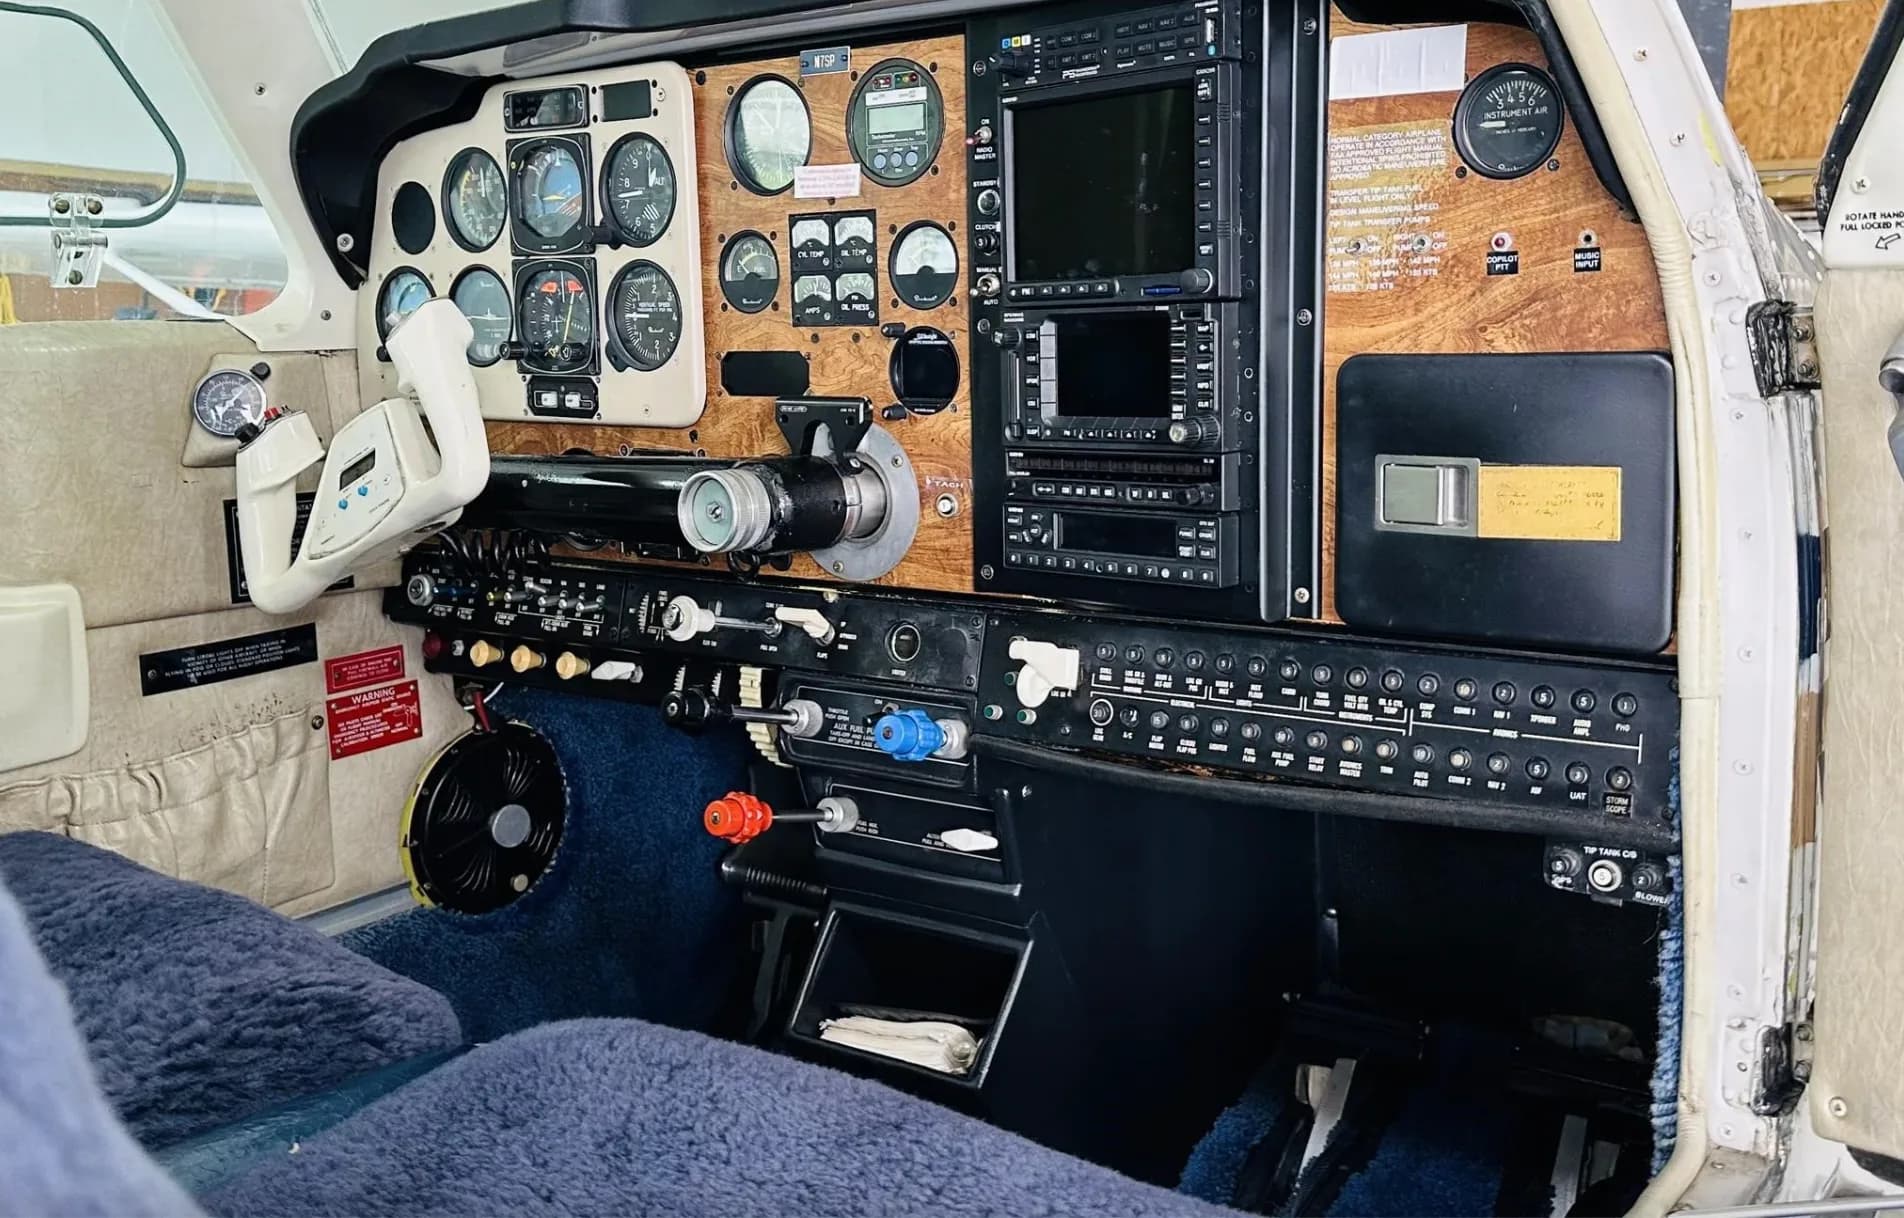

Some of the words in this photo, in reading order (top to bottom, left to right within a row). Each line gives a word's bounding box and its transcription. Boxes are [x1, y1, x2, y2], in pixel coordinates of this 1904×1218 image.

[1497, 99, 1504, 110] 3
[1507, 94, 1515, 103] 4
[1519, 92, 1525, 102] 5
[1528, 96, 1535, 106] 6
[1484, 109, 1531, 119] INSTRUMENT
[1534, 107, 1548, 115] AIR
[1363, 132, 1403, 141] CATEGORY
[1405, 129, 1441, 137] AIRPLANE
[1330, 142, 1364, 150] OPERATE
[1374, 137, 1425, 147] ACCORDANCE
[1346, 148, 1384, 157] APPROVED
[1385, 146, 1412, 154] FLIGHT
[632, 159, 638, 168] 9
[624, 178, 630, 187] 8
[1391, 192, 1412, 200] ONLY
[624, 200, 630, 208] 7
[1846, 212, 1877, 221] ROTATE
[1880, 210, 1904, 219] HAND
[635, 217, 641, 226] 6
[1840, 223, 1857, 231] FULL
[1861, 221, 1892, 230] LOCKED
[650, 224, 656, 233] 5
[1487, 255, 1518, 263] COPILOT
[1575, 252, 1599, 260] MUSIC
[1575, 260, 1598, 268] INPUT
[652, 285, 657, 294] 2
[672, 312, 678, 321] 4
[669, 332, 676, 342] 3
[655, 340, 660, 349] 2
[1146, 567, 1153, 575] 7
[352, 687, 395, 704] WARNING
[1540, 693, 1547, 702] 5
[1580, 697, 1587, 705] 5
[850, 725, 864, 733] FUEL
[1534, 765, 1540, 773] 5
[1570, 792, 1587, 800] UAT
[1606, 797, 1629, 805] STORM
[1605, 805, 1626, 814] SCOPE
[1599, 848, 1621, 857] TANK
[1556, 861, 1562, 869] 5
[1600, 872, 1605, 880] 5
